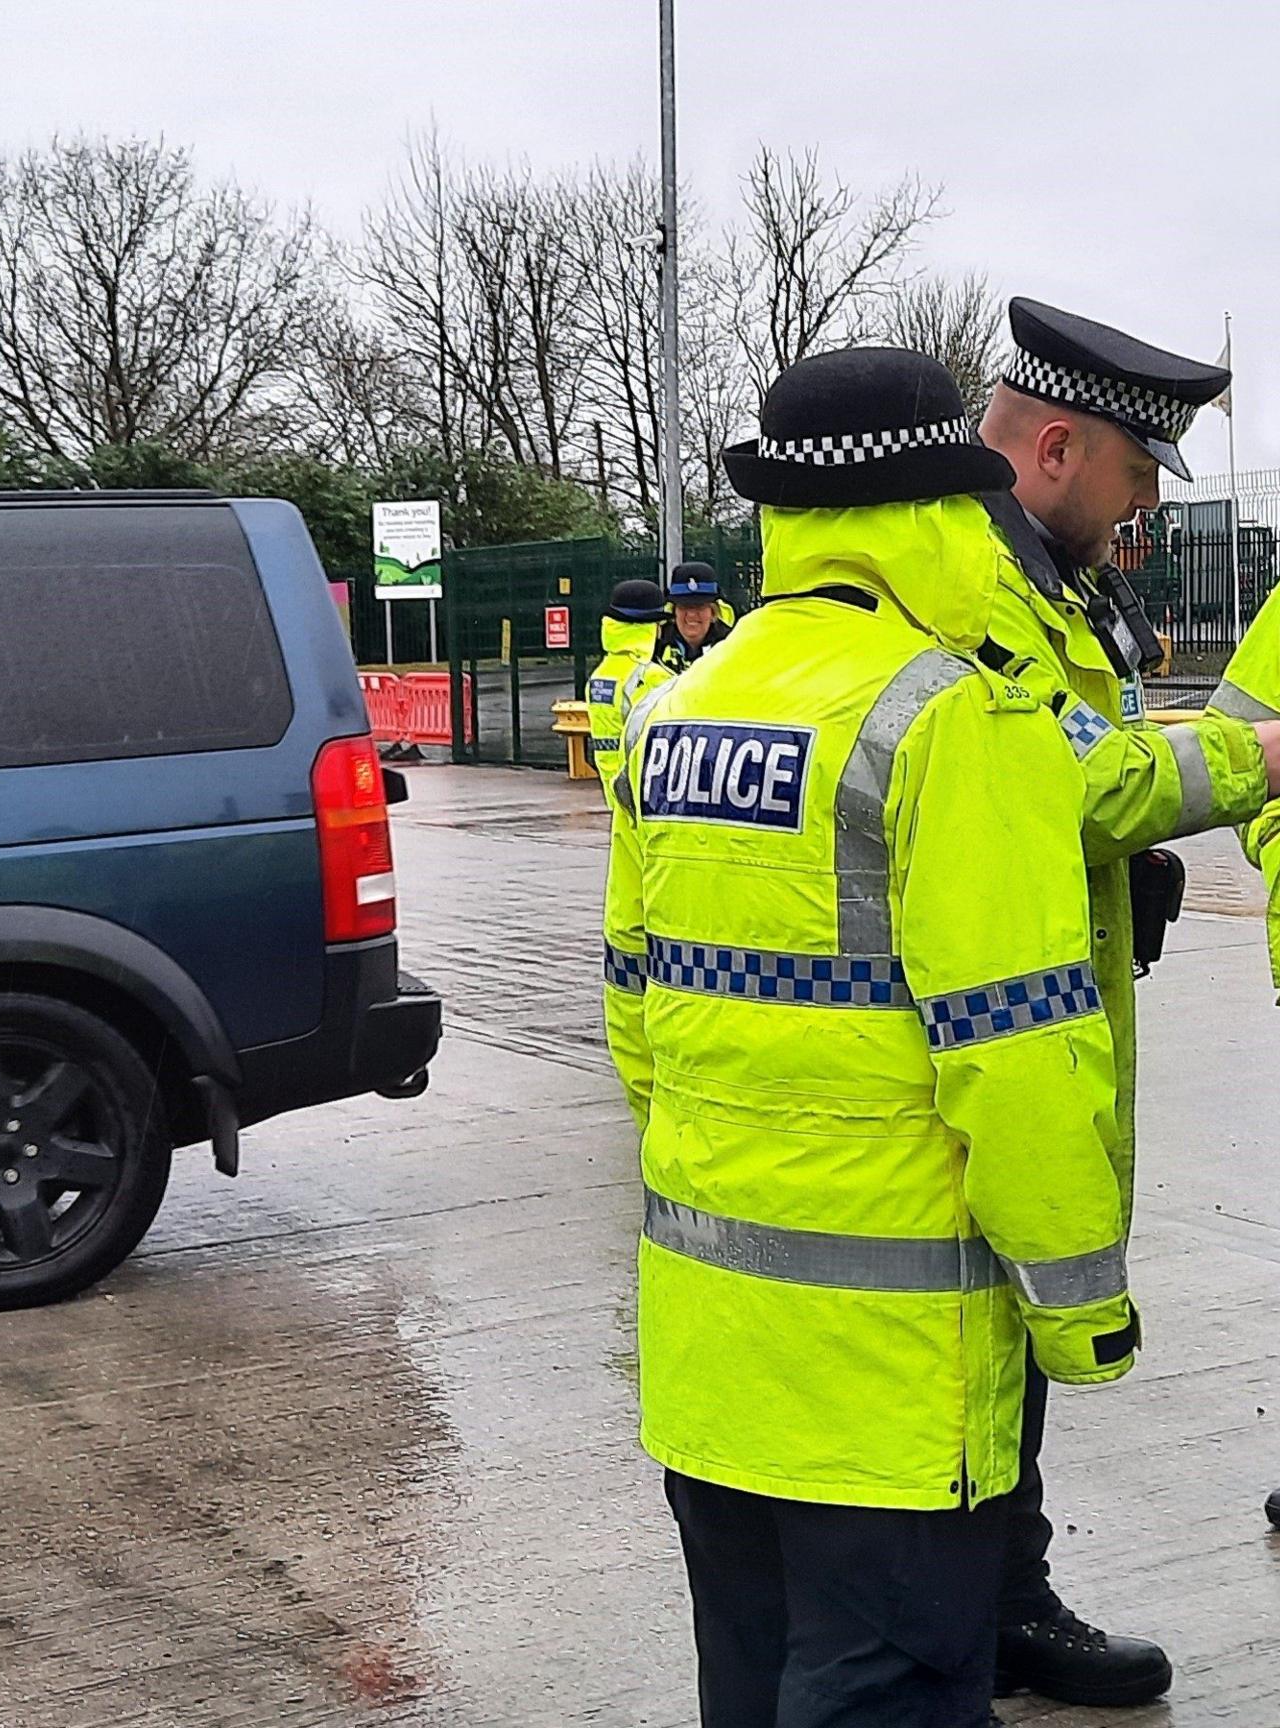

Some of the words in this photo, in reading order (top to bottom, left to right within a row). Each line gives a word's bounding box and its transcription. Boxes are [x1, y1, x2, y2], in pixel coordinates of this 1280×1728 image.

[381, 506, 410, 517] Thank
[411, 505, 431, 518] you!
[1004, 685, 1031, 700] 335
[1121, 693, 1136, 712] CE
[643, 735, 800, 813] POLICE
